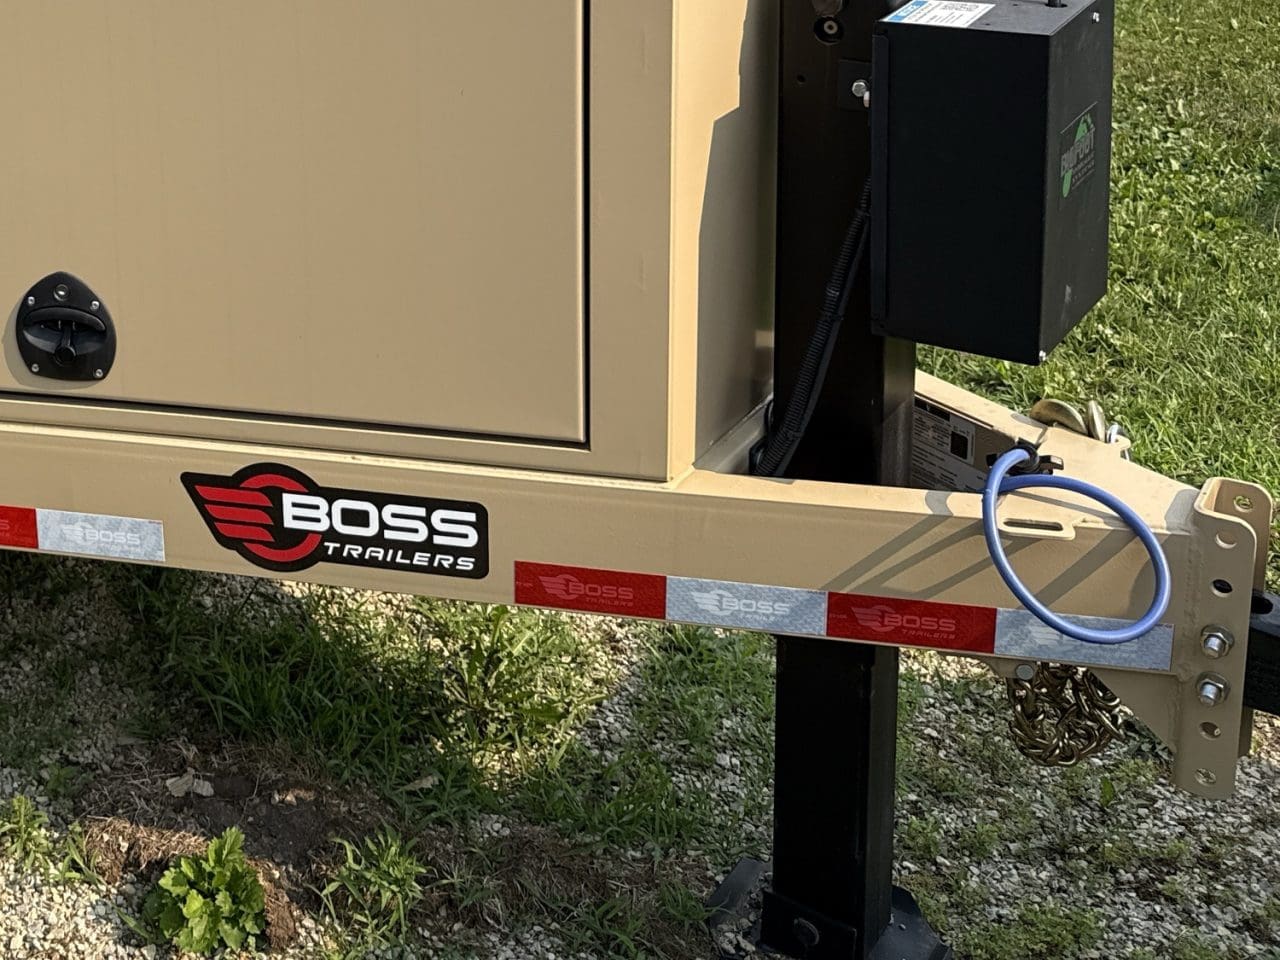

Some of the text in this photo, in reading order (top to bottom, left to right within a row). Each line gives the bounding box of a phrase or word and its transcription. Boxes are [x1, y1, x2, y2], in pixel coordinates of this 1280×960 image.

[282, 493, 479, 548] BOSS
[85, 526, 141, 545] BOSS
[323, 542, 475, 571] TRAILERS
[569, 581, 634, 600] BOSS
[722, 597, 790, 615] BOSS
[883, 613, 956, 632] BOSS
